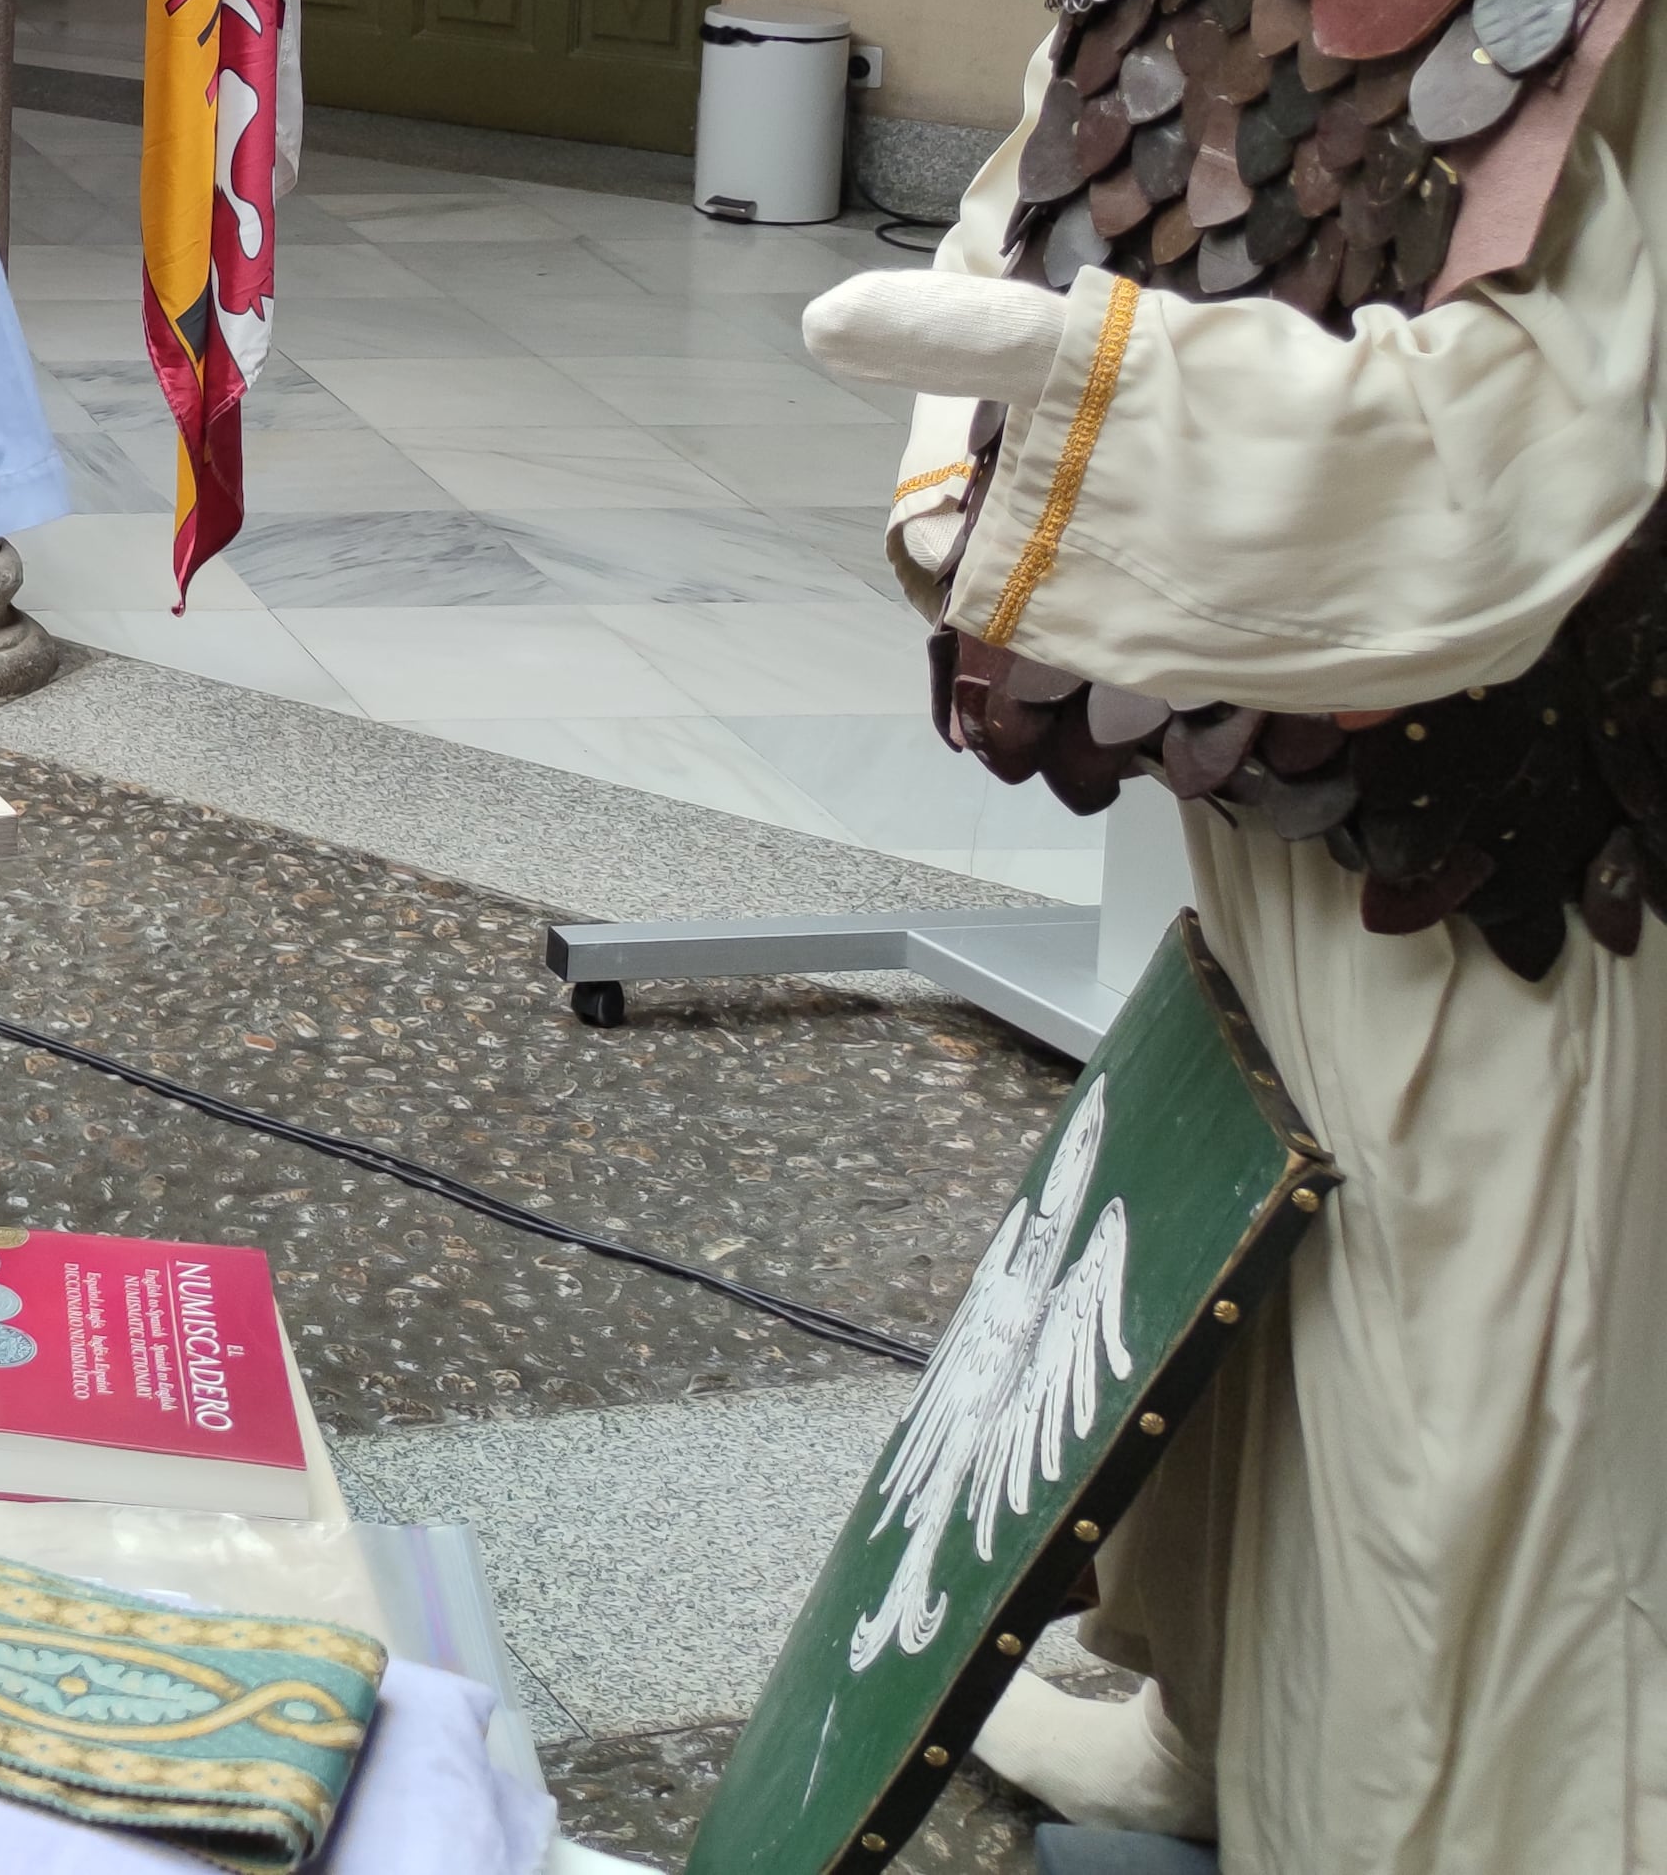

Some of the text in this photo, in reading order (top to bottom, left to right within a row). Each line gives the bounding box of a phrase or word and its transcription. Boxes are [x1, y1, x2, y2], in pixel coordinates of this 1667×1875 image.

[141, 1268, 164, 1299] English
[124, 1274, 153, 1400] NUMISMATIC DICTIONARY
[175, 1260, 234, 1432] NUMISCADERO
[226, 1344, 246, 1358] EL
